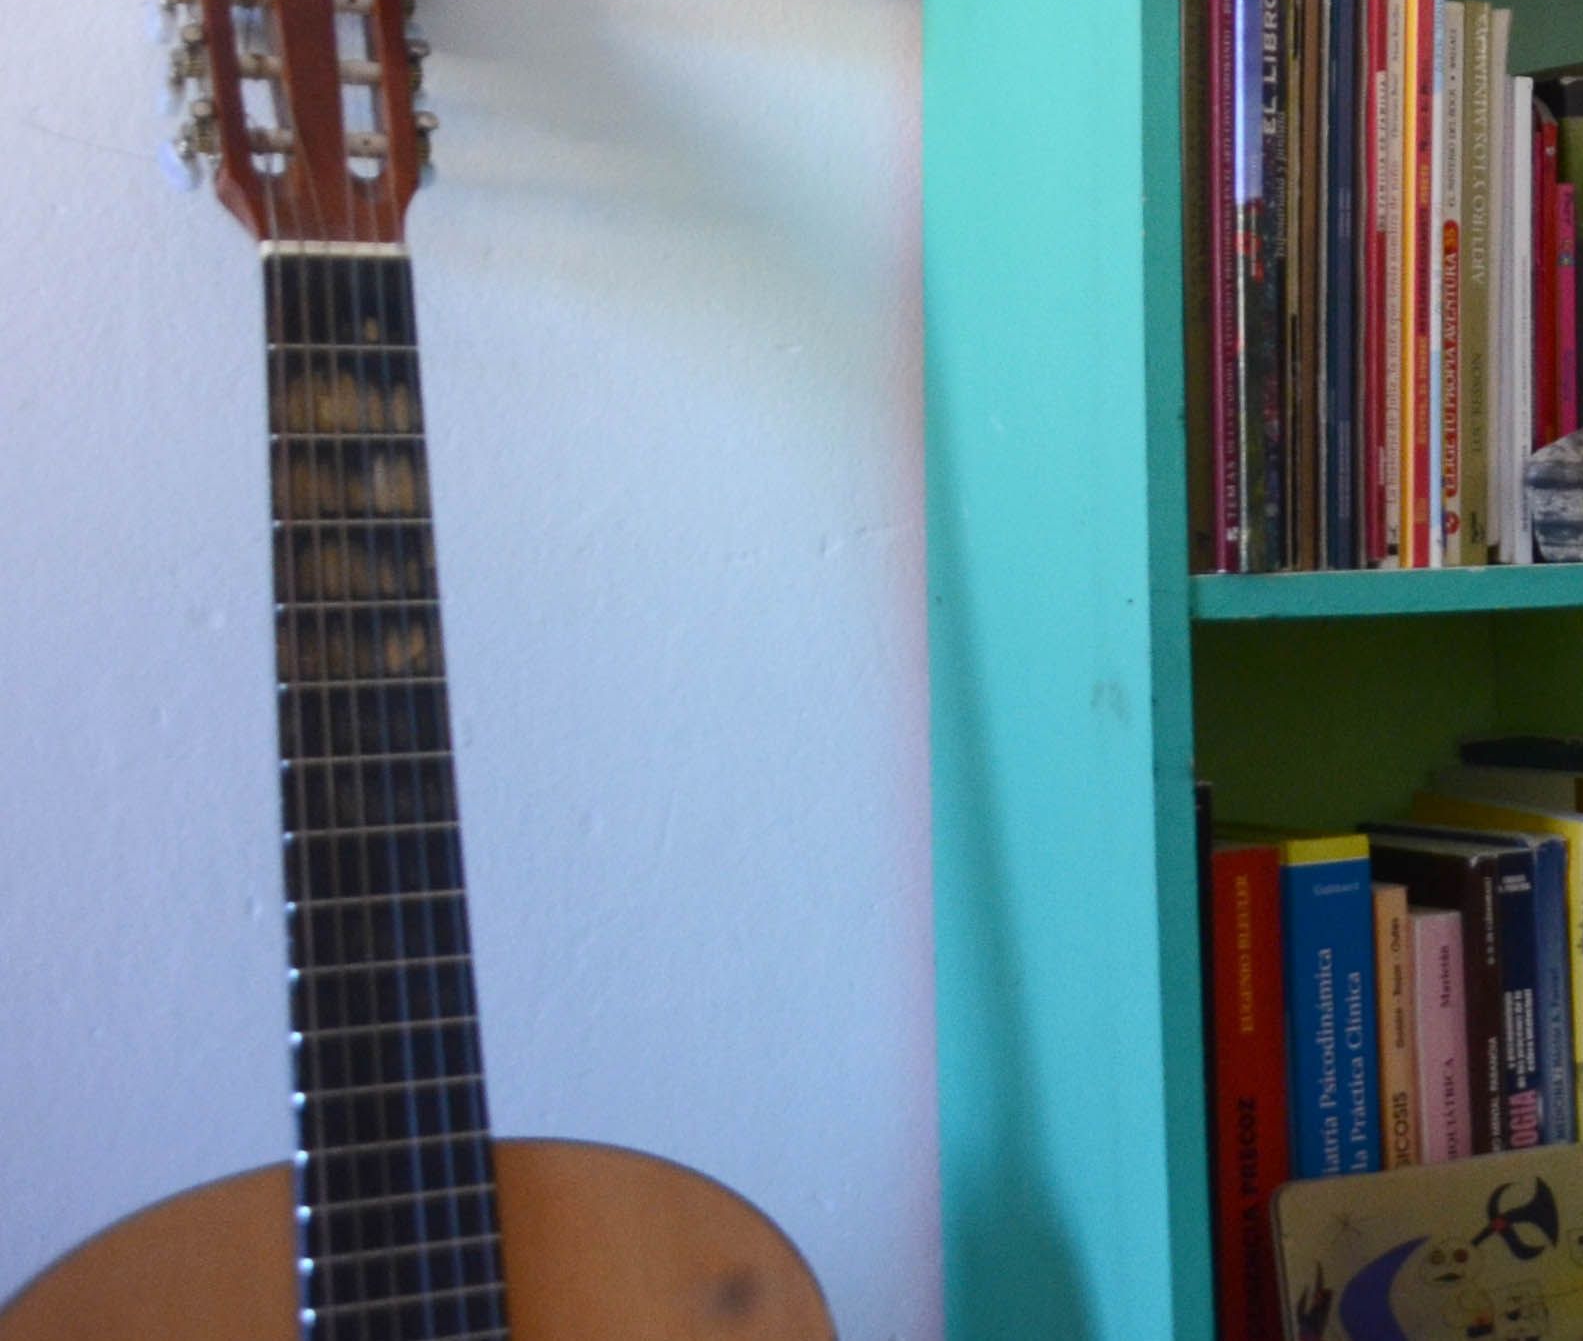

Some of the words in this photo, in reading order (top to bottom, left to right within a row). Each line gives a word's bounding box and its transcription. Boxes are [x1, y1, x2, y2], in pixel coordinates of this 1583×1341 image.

[1263, 95, 1279, 135] EL
[1471, 128, 1488, 172] LOS
[1471, 176, 1488, 190] Y
[1471, 194, 1488, 283] ARTURO
[1443, 251, 1458, 342] AVENTURA
[1443, 346, 1457, 409] PROPIA
[1444, 412, 1457, 433] TU
[1444, 439, 1457, 489] ELIGE
[1314, 948, 1338, 1109] Psicodinámica
[1345, 971, 1364, 1051] Clínica
[1347, 1057, 1368, 1142] Práctica
[1315, 1115, 1339, 1175] iatría
[1348, 1148, 1368, 1170] la
